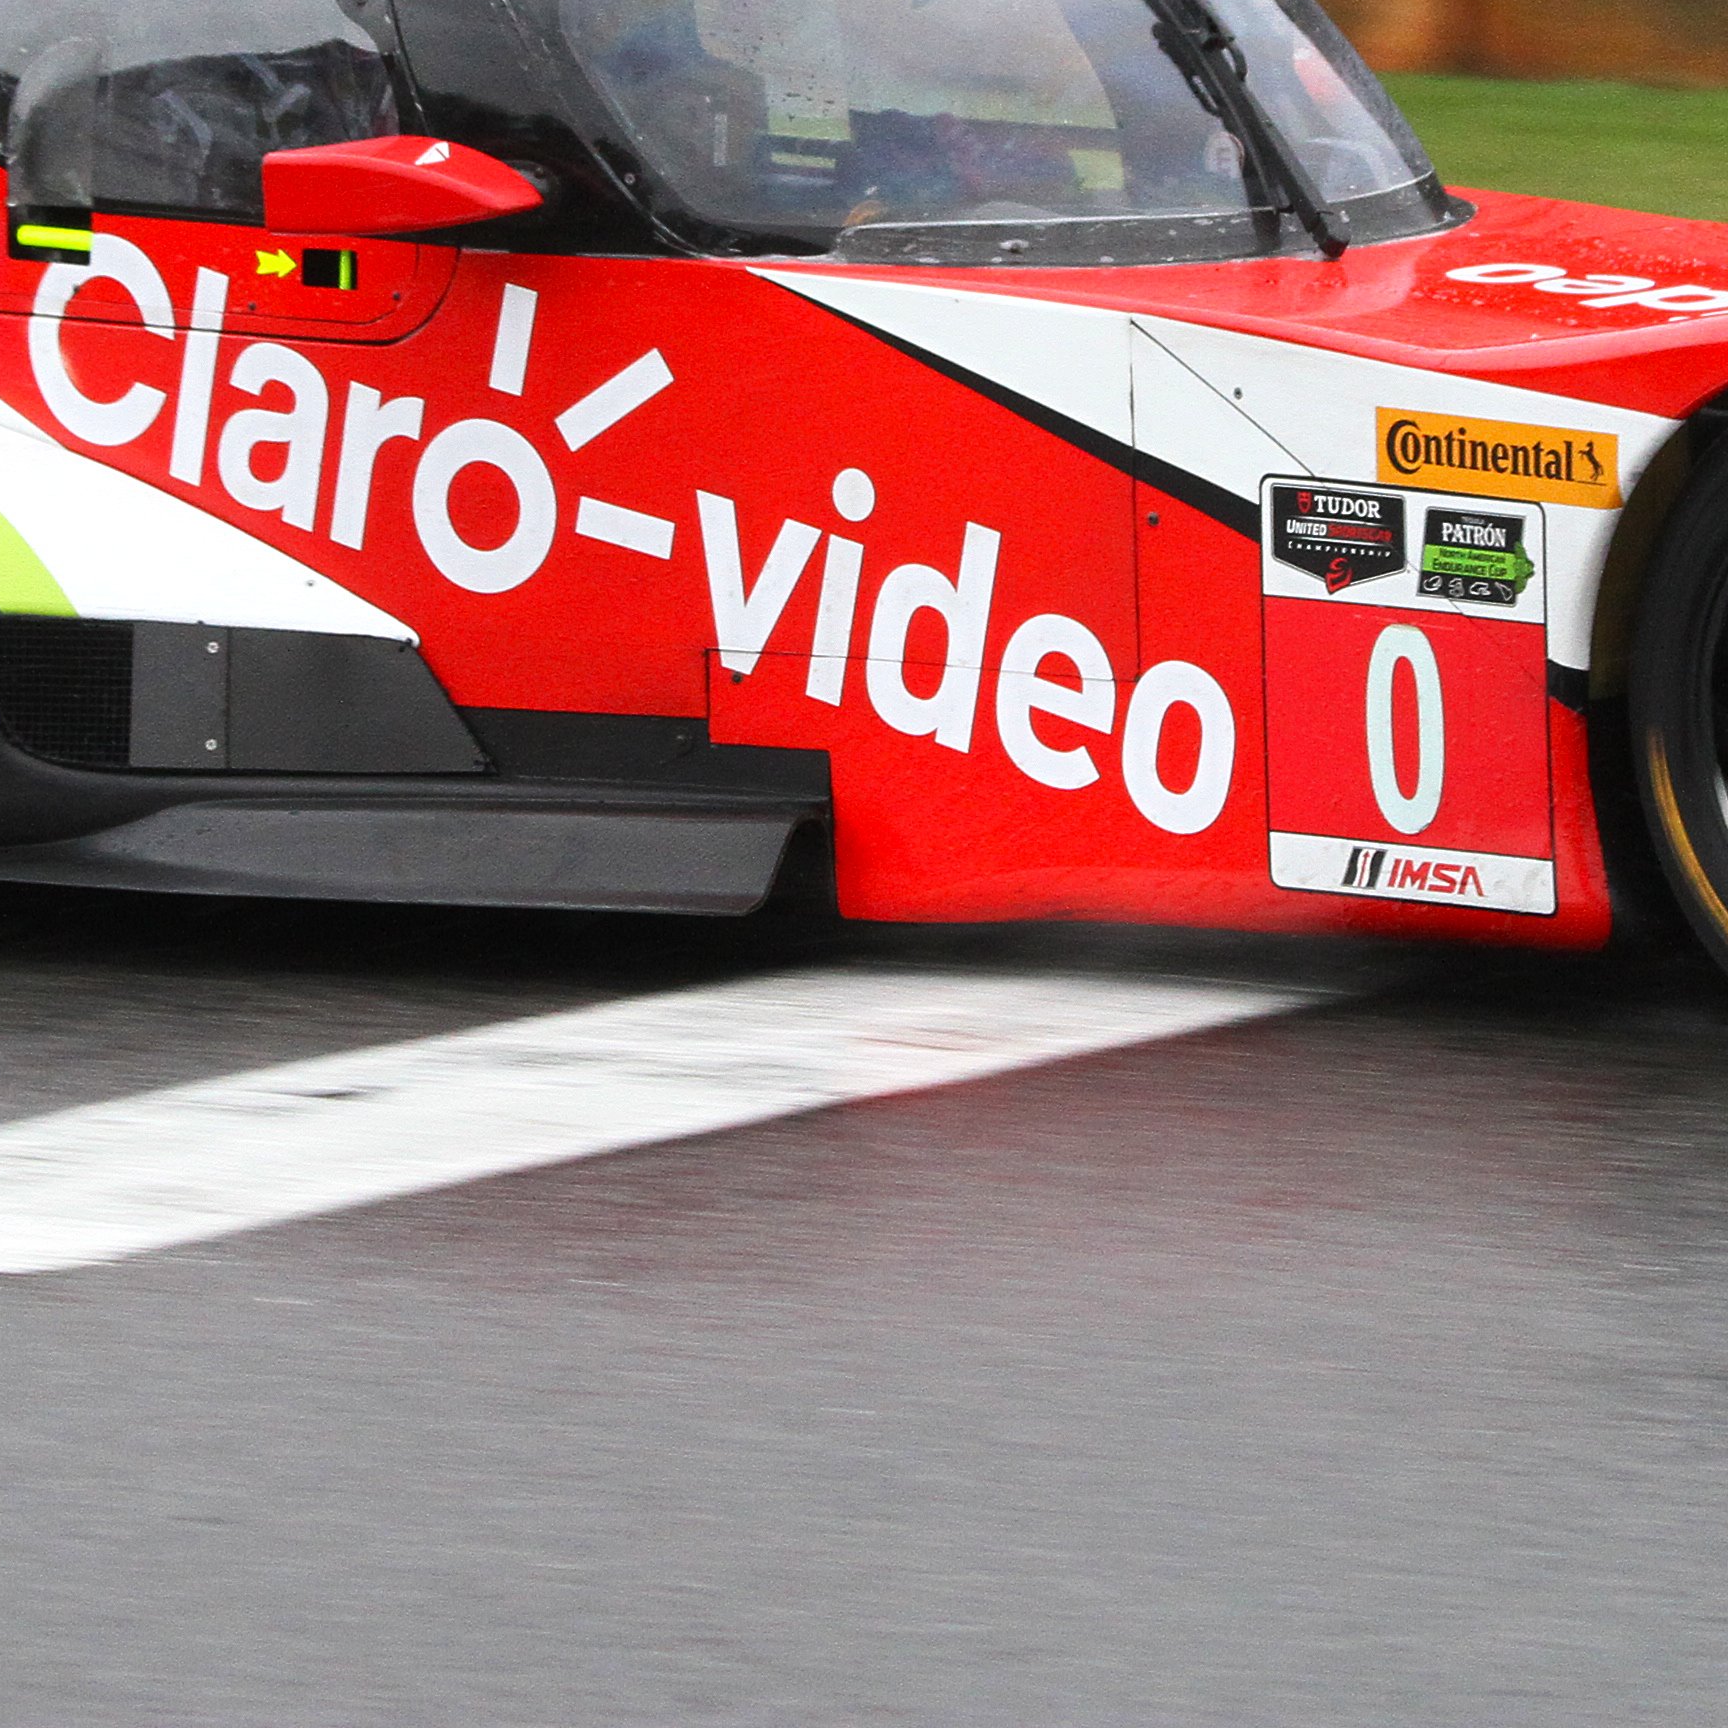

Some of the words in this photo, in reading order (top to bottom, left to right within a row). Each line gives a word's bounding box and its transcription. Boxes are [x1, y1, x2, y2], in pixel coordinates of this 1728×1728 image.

[27, 232, 559, 595] Claro
[1385, 418, 1574, 481] Continental
[1313, 495, 1382, 520] TUDOR
[1286, 519, 1327, 537] UNITED
[1441, 522, 1508, 548] PATRÓN
[1287, 540, 1392, 558] CHAMPIONSHIP
[696, 467, 1237, 837] video
[1366, 623, 1446, 835] 0
[1386, 858, 1485, 898] IMSA
